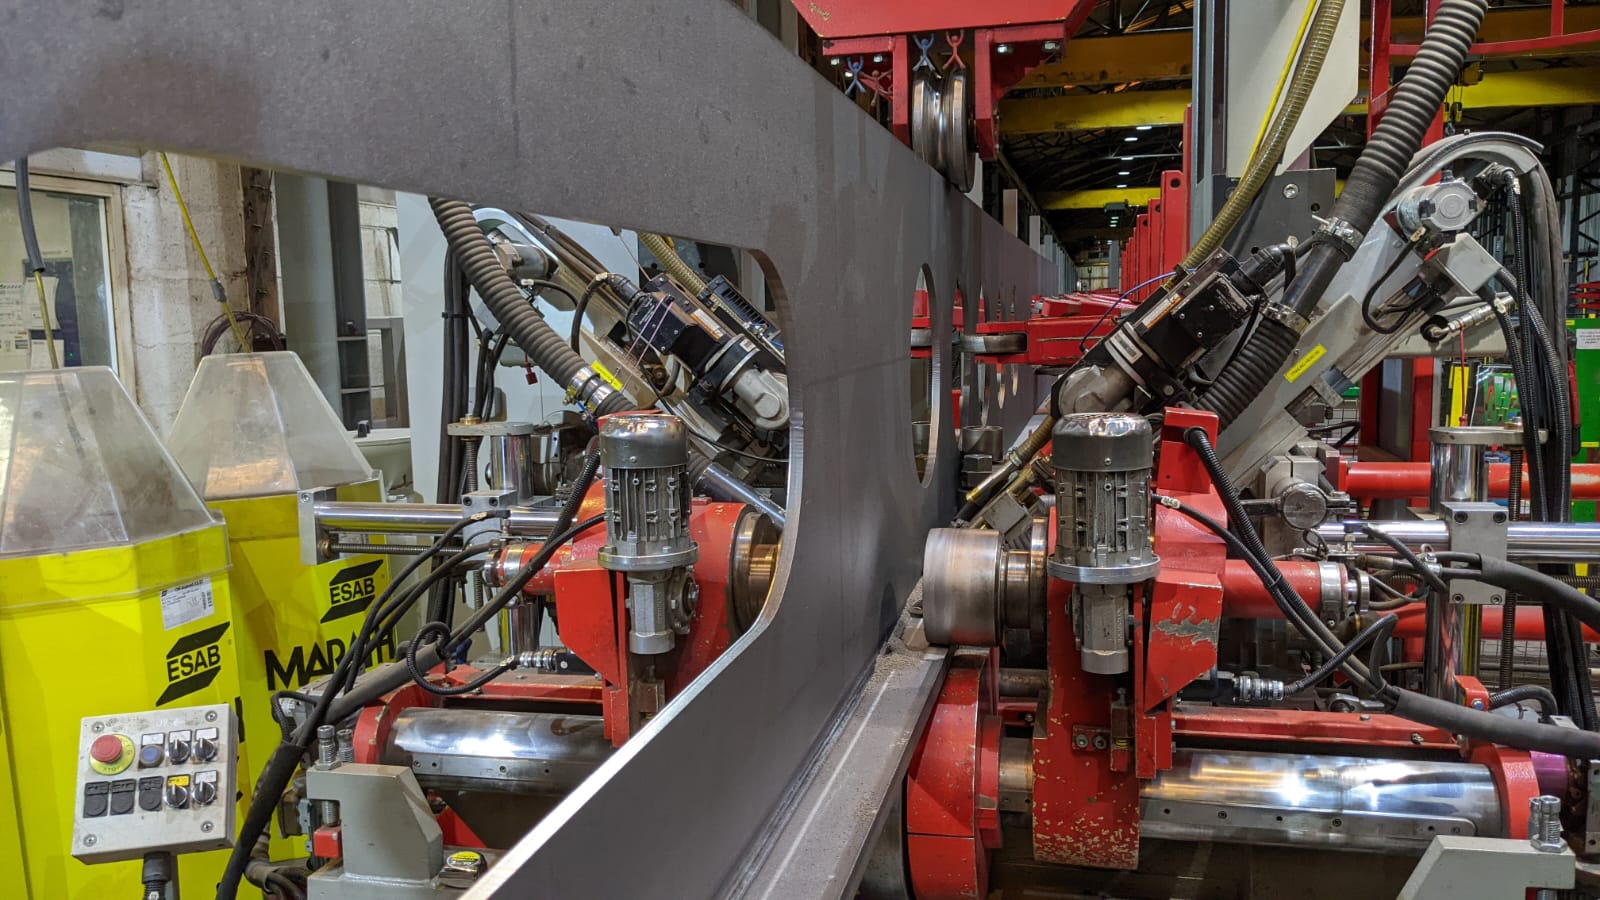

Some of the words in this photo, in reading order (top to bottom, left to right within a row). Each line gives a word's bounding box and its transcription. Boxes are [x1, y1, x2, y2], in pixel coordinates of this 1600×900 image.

[329, 577, 376, 605] ESAB
[167, 644, 221, 682] ESAB
[264, 630, 396, 692] MARH
